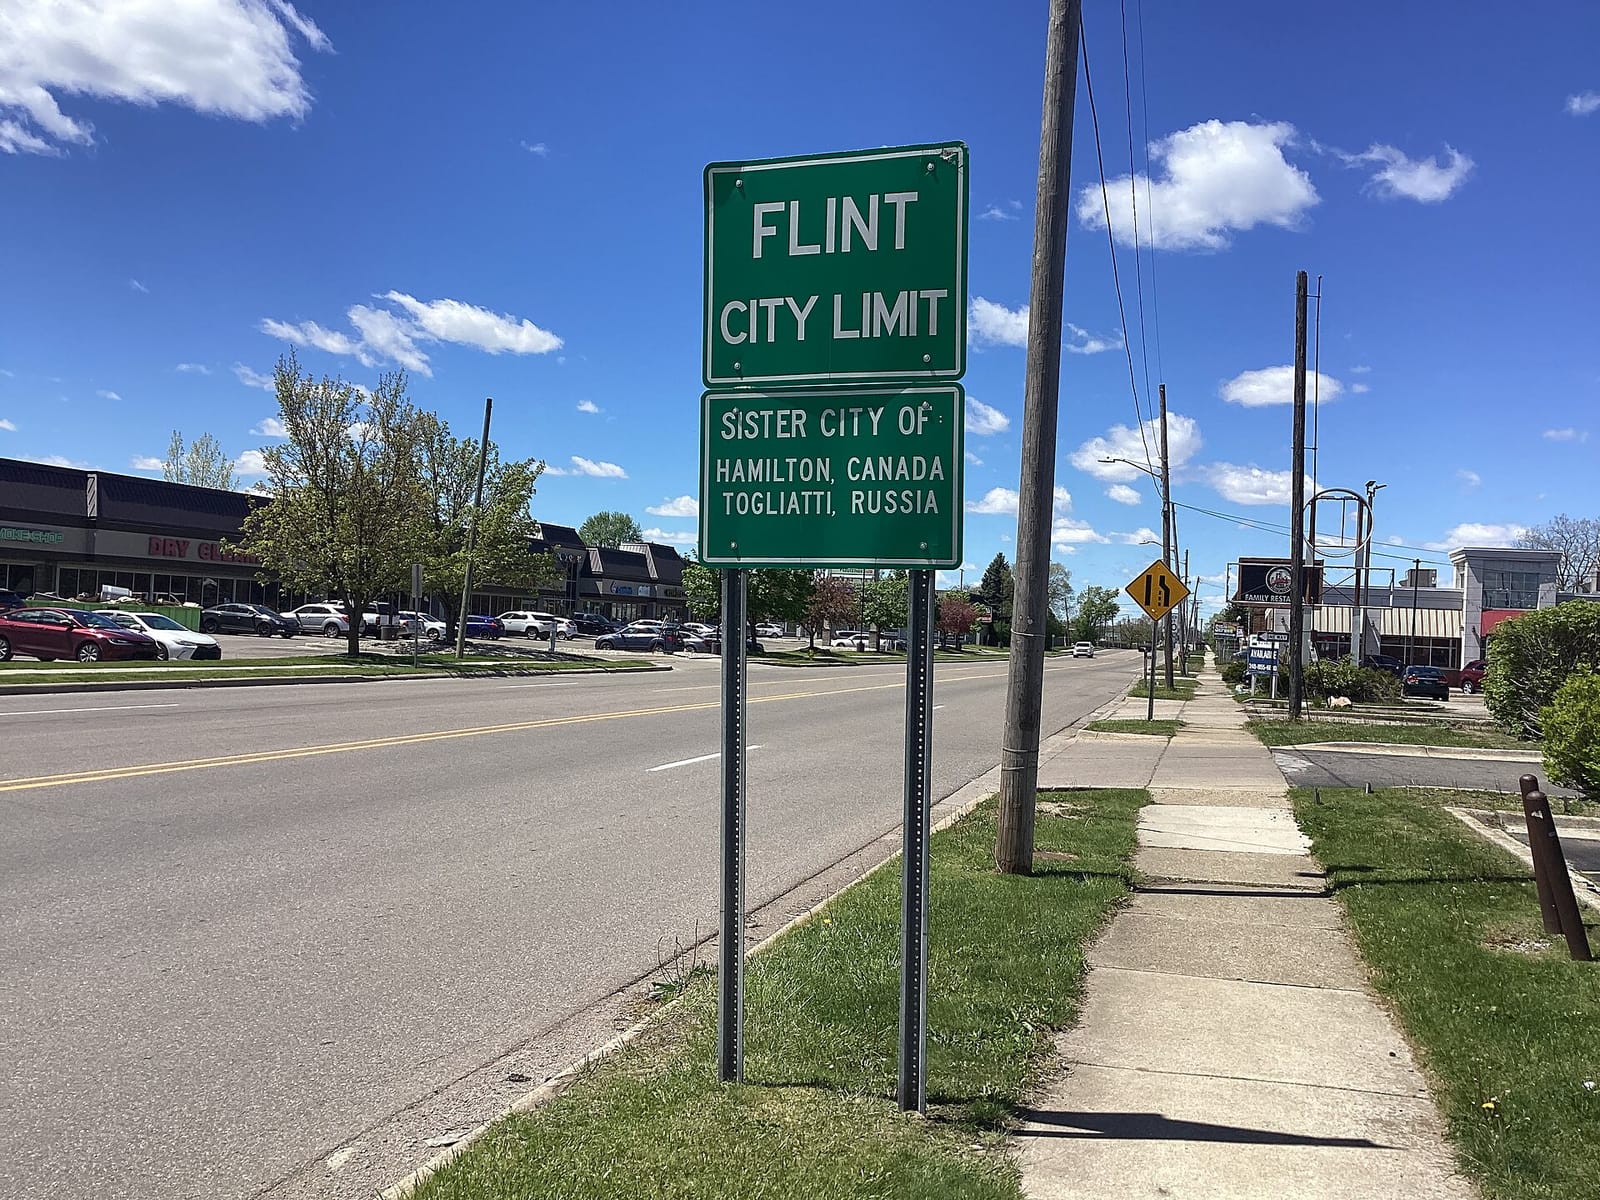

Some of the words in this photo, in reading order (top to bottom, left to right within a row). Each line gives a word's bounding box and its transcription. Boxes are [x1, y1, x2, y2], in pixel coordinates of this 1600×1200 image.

[752, 191, 919, 259] FLINT
[720, 295, 819, 344] CITY
[833, 289, 948, 339] LIMIT
[721, 409, 807, 440] SISTER
[820, 407, 884, 437] CITY
[716, 457, 835, 485] HAMILTON,
[847, 456, 945, 481] CANADA
[723, 491, 836, 517] TOGLIATTI,
[851, 490, 939, 514] RUSSIA
[31, 530, 65, 544] SHOP
[149, 536, 191, 558] DRY
[1244, 594, 1269, 602] FAMILY
